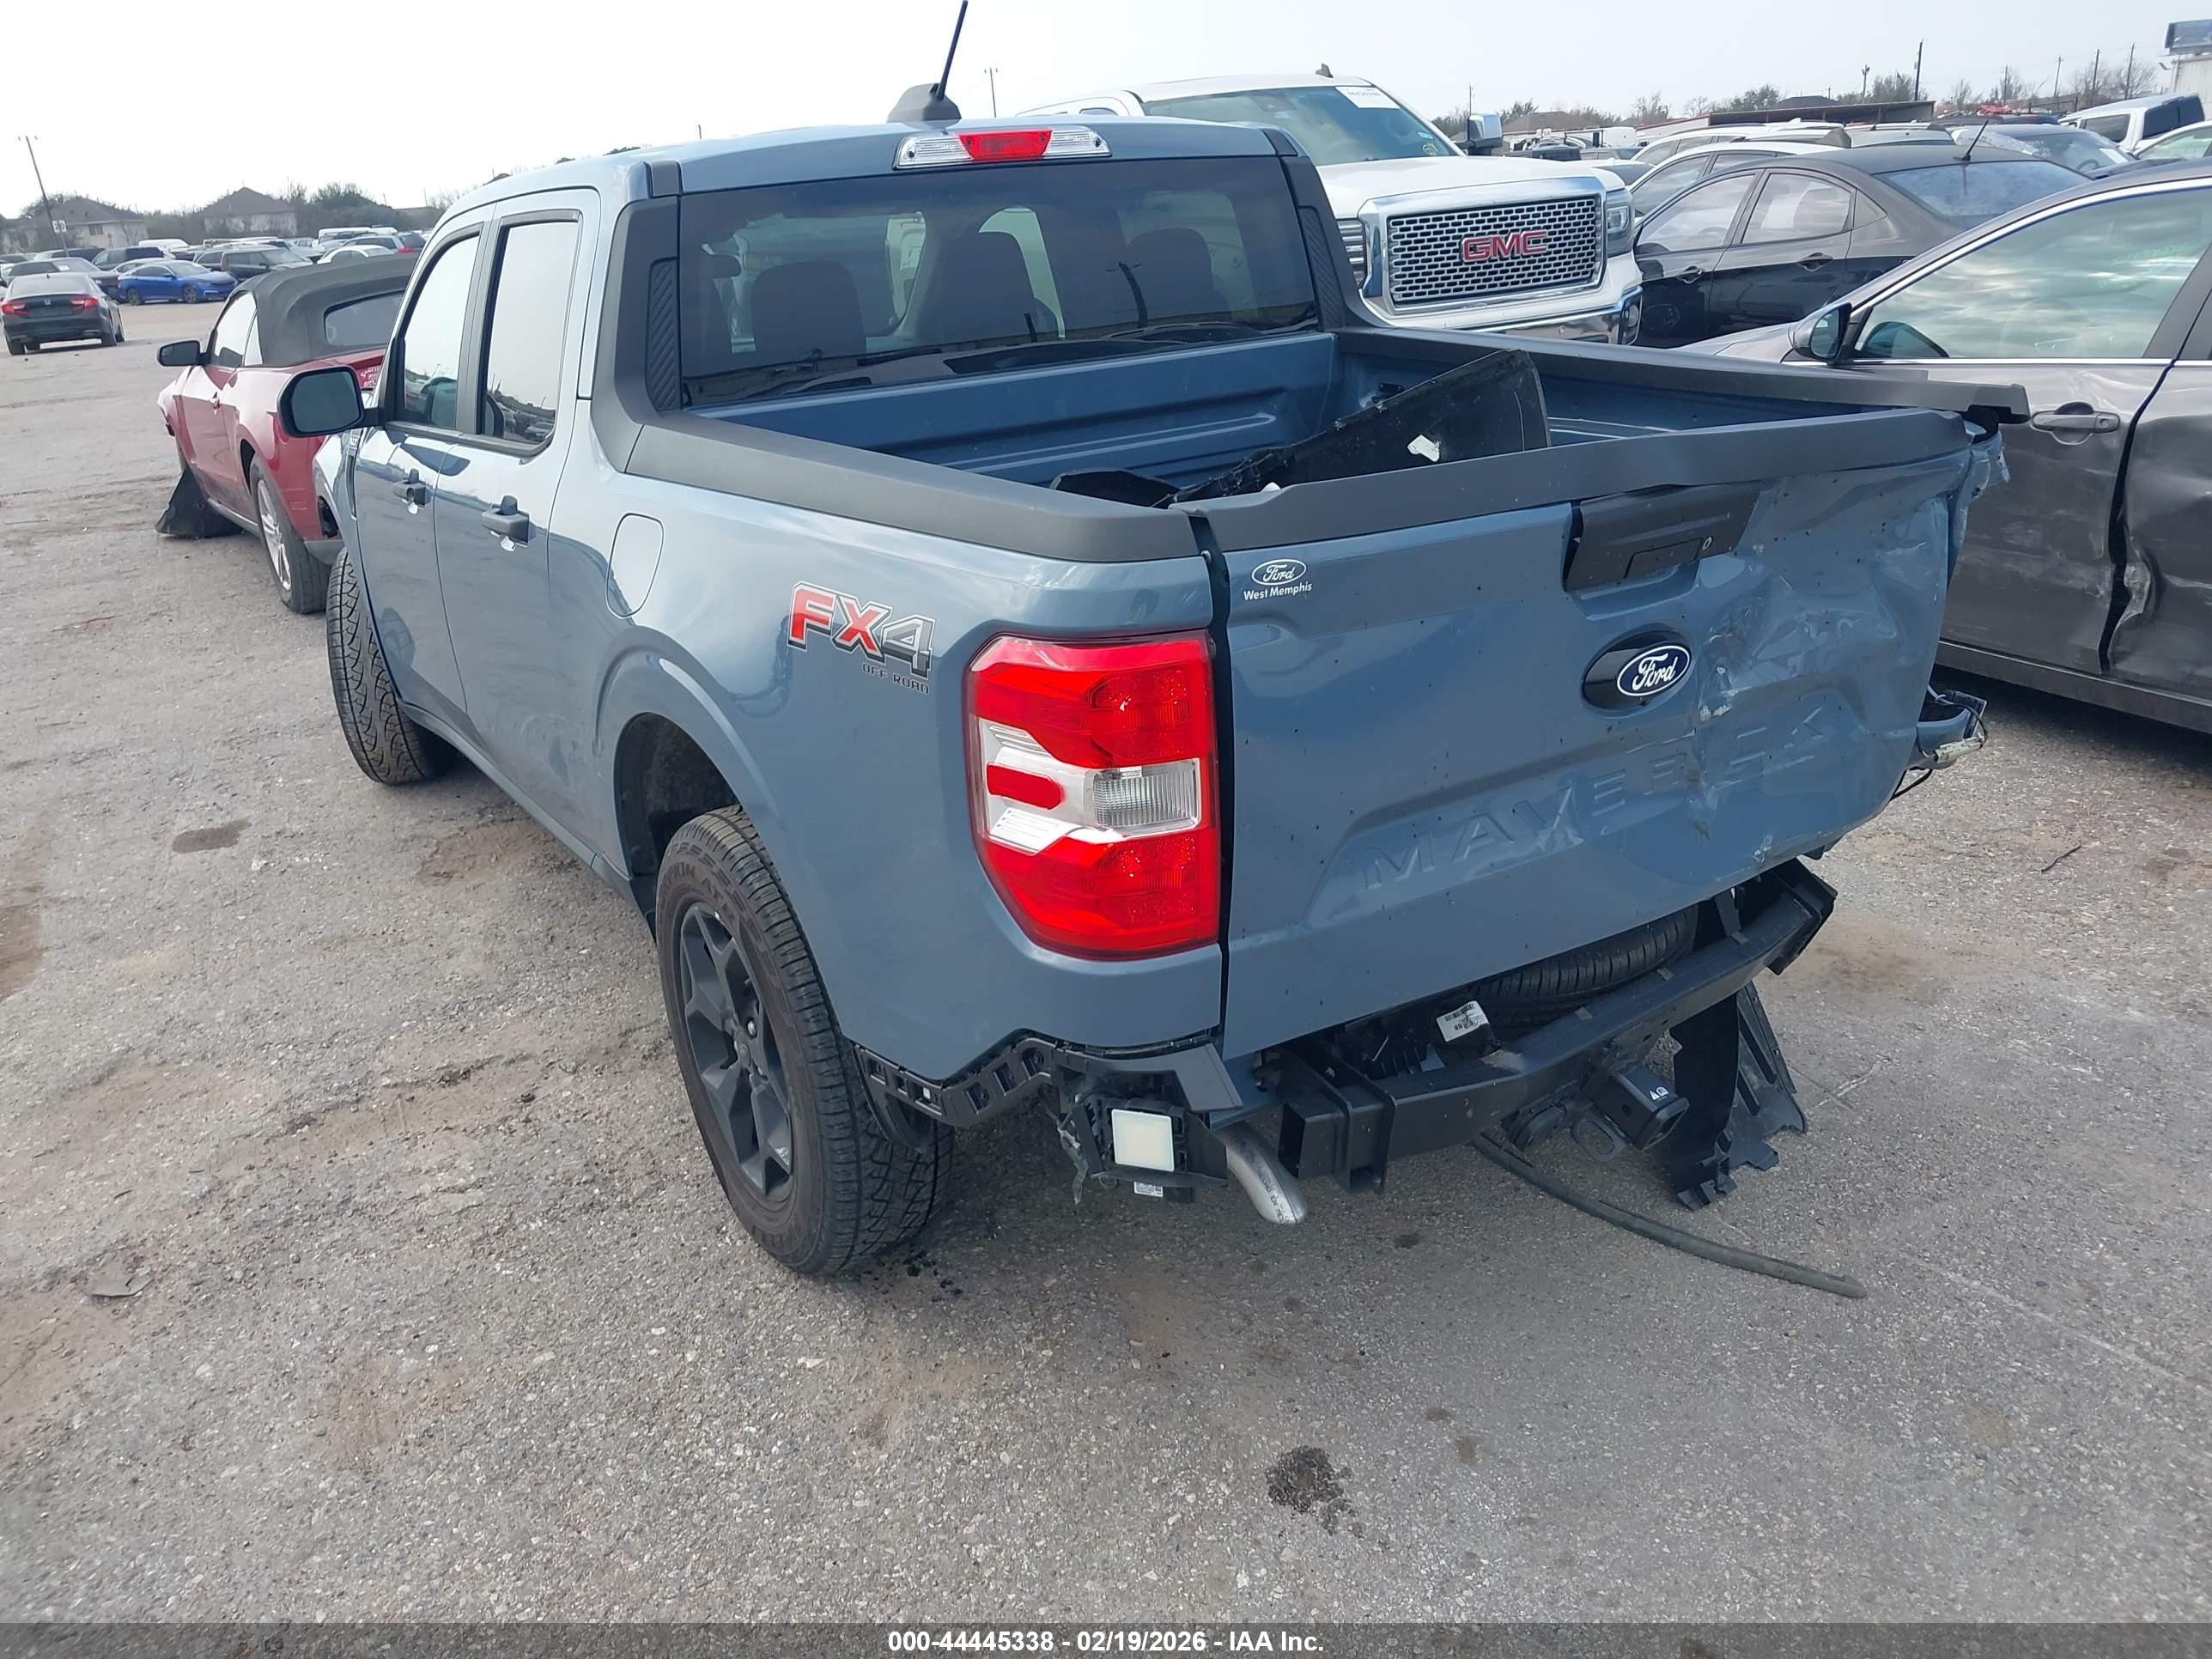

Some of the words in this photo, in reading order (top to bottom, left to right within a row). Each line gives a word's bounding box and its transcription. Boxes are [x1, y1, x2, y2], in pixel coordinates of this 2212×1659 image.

[1462, 229, 1547, 262] GMC
[1243, 588, 1268, 601] West
[1270, 581, 1313, 598] Memphis
[787, 580, 936, 680] FX4
[862, 663, 889, 680] OFF
[893, 673, 930, 695] ROAD
[1632, 653, 1679, 691] Ford
[1360, 706, 1827, 892] MAVERCK
